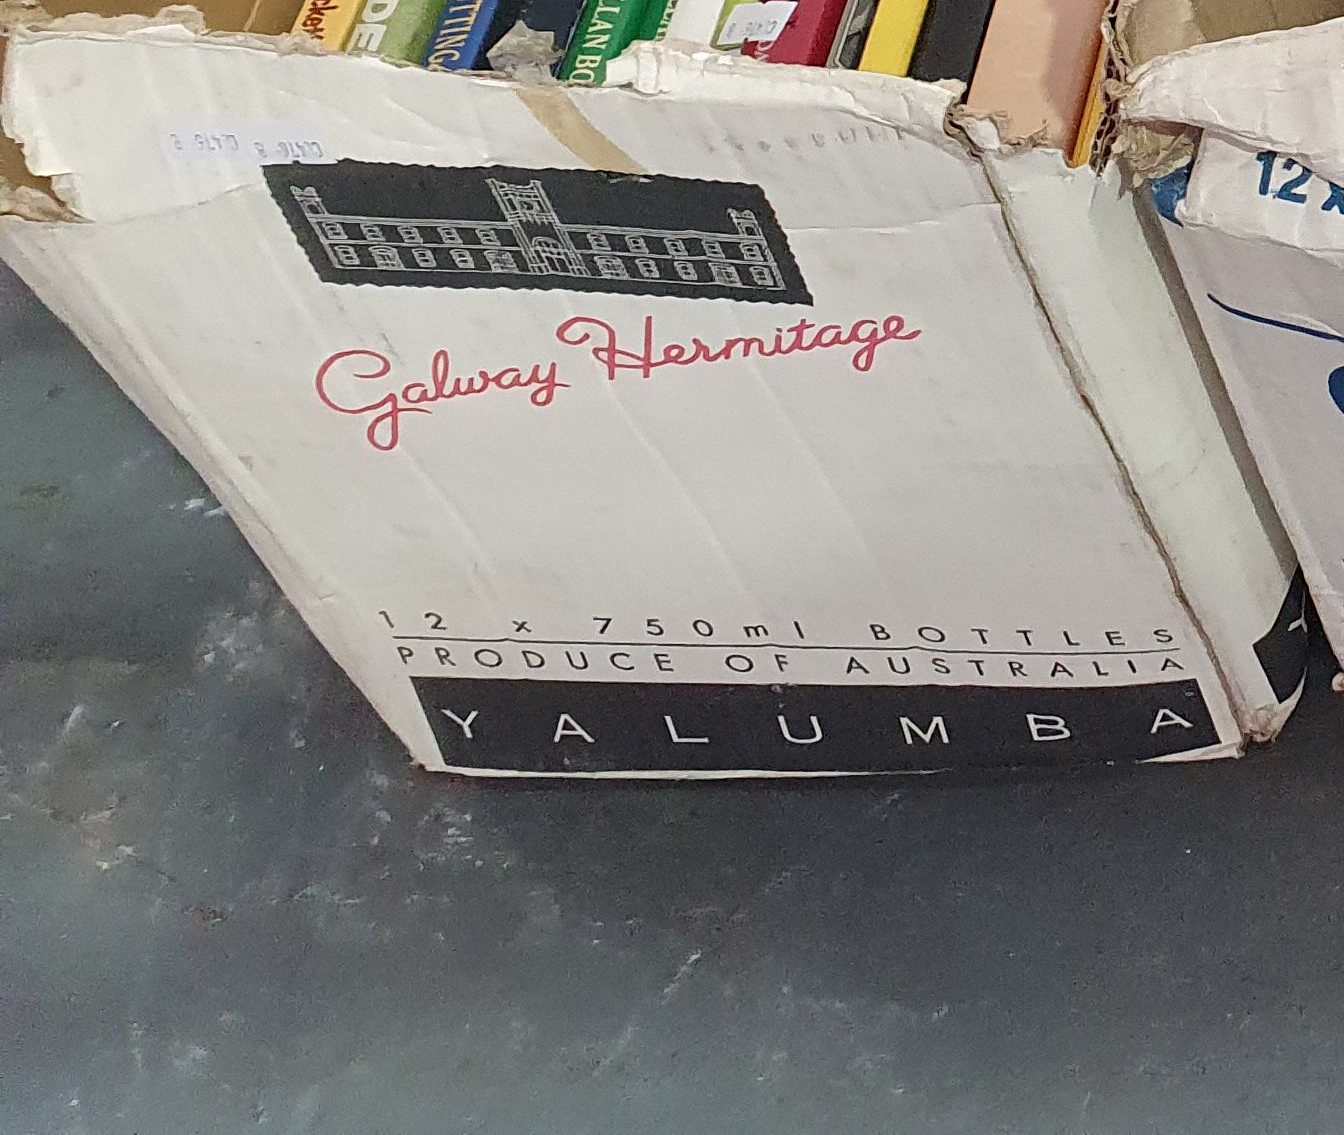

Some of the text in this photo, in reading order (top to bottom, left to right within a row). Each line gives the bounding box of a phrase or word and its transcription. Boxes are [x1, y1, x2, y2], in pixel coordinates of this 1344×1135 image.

[1256, 149, 1309, 203] 12
[315, 313, 922, 451] Galway Hermitage
[378, 610, 1176, 647] 12 x 750ml BOTTLES
[398, 645, 1185, 678] PRODUCE OF AUSTRALIA
[439, 706, 1195, 746] YALUMBA
